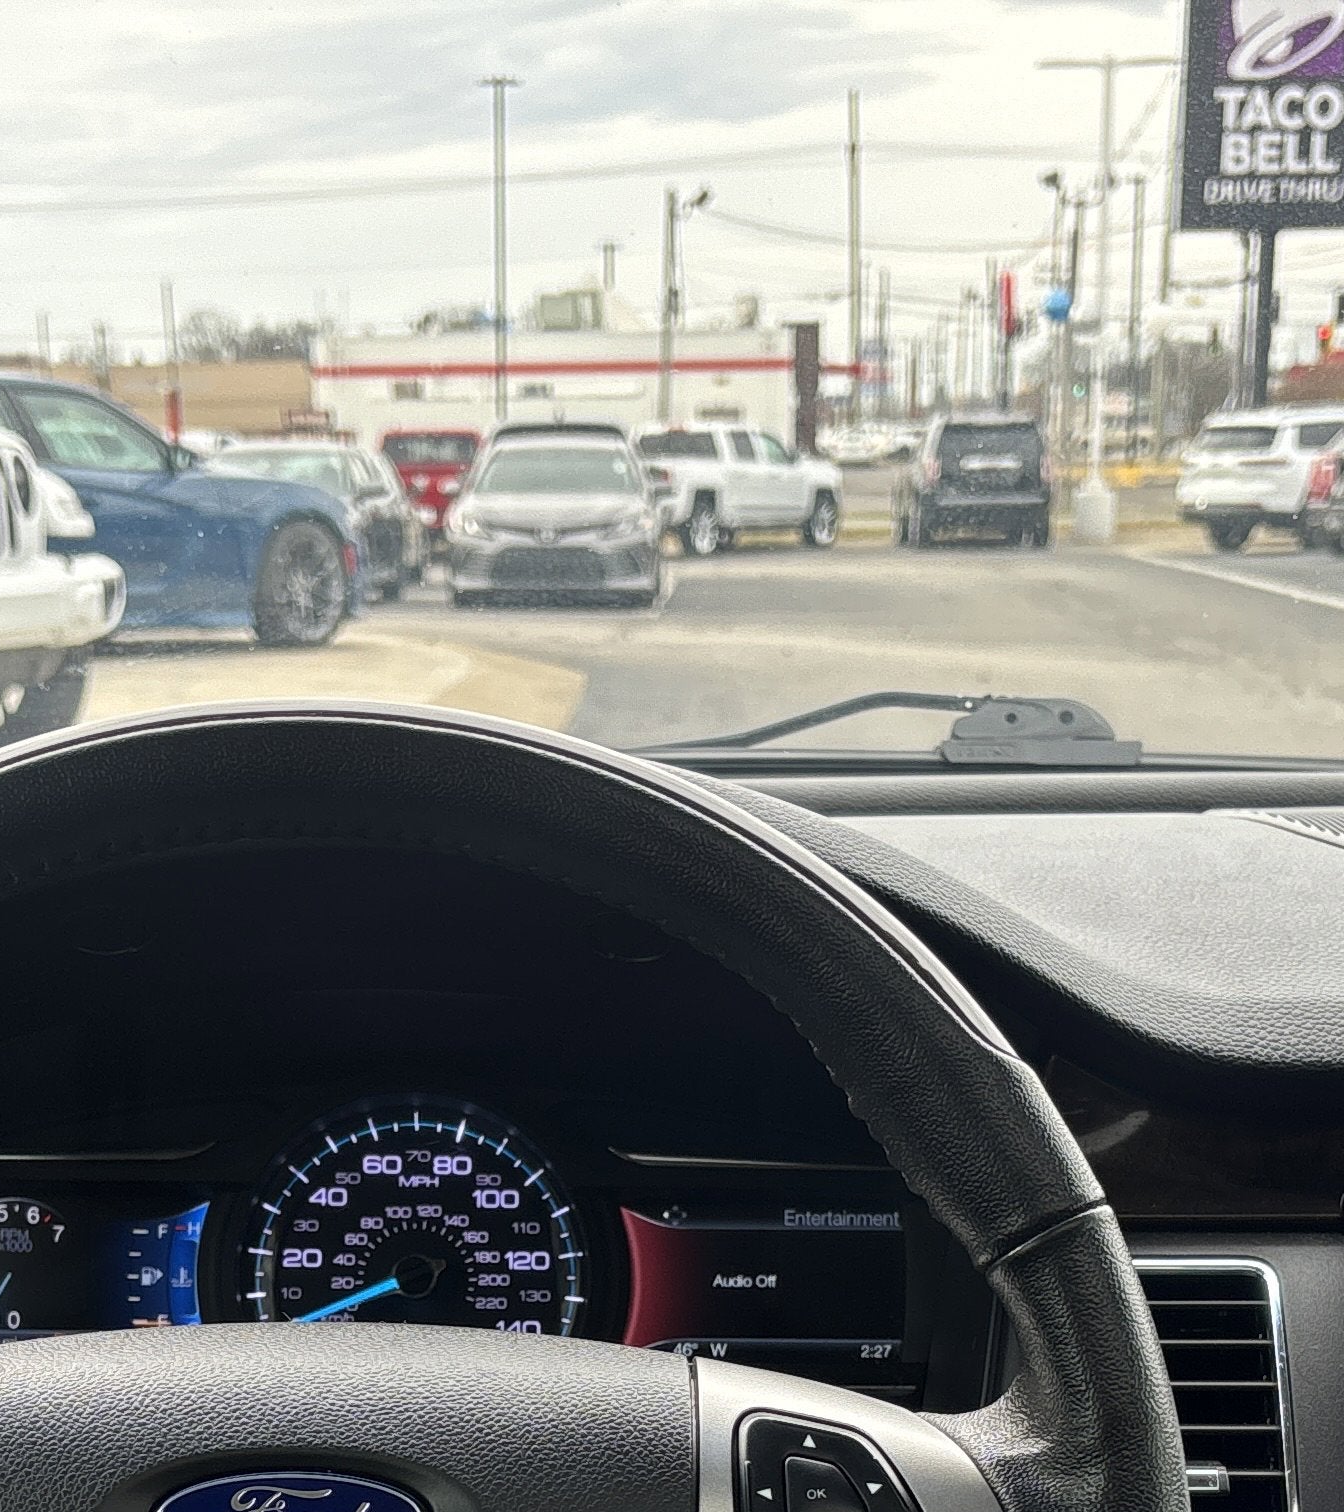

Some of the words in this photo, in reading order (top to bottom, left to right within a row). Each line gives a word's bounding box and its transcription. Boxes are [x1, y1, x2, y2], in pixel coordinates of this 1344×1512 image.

[1219, 130, 1344, 175] BELL
[406, 1150, 431, 1162] 70
[363, 1155, 402, 1174] 60
[433, 1156, 472, 1175] 80
[335, 1172, 361, 1184] 50
[399, 1175, 439, 1187] MPH
[476, 1174, 501, 1186] 90
[309, 1187, 347, 1206] 40
[472, 1190, 519, 1208] 100
[27, 1206, 40, 1224] 6
[385, 1207, 412, 1218] 100
[417, 1206, 442, 1217] 120
[360, 1217, 384, 1230] 80
[443, 1215, 469, 1227] 140
[783, 1209, 900, 1227] Entertainment
[158, 1224, 168, 1238] F
[187, 1222, 200, 1236] H
[294, 1220, 319, 1232] 30
[512, 1222, 540, 1234] 110
[0, 1229, 30, 1242] RPM
[53, 1225, 64, 1242] 7
[345, 1233, 368, 1245] 60
[462, 1231, 488, 1243] 160
[283, 1248, 322, 1267] 20
[333, 1254, 355, 1265] 40
[474, 1251, 500, 1263] 180
[504, 1251, 550, 1270] 120
[331, 1277, 354, 1289] 20
[478, 1274, 510, 1286] 200
[713, 1275, 752, 1287] Audio
[756, 1275, 777, 1288] Off
[282, 1287, 302, 1299] 10
[520, 1290, 551, 1302] 130
[475, 1297, 507, 1309] 220
[8, 1311, 20, 1329] 0
[710, 1343, 727, 1356] W
[861, 1344, 891, 1358] 2:27
[807, 1489, 826, 1499] OK
